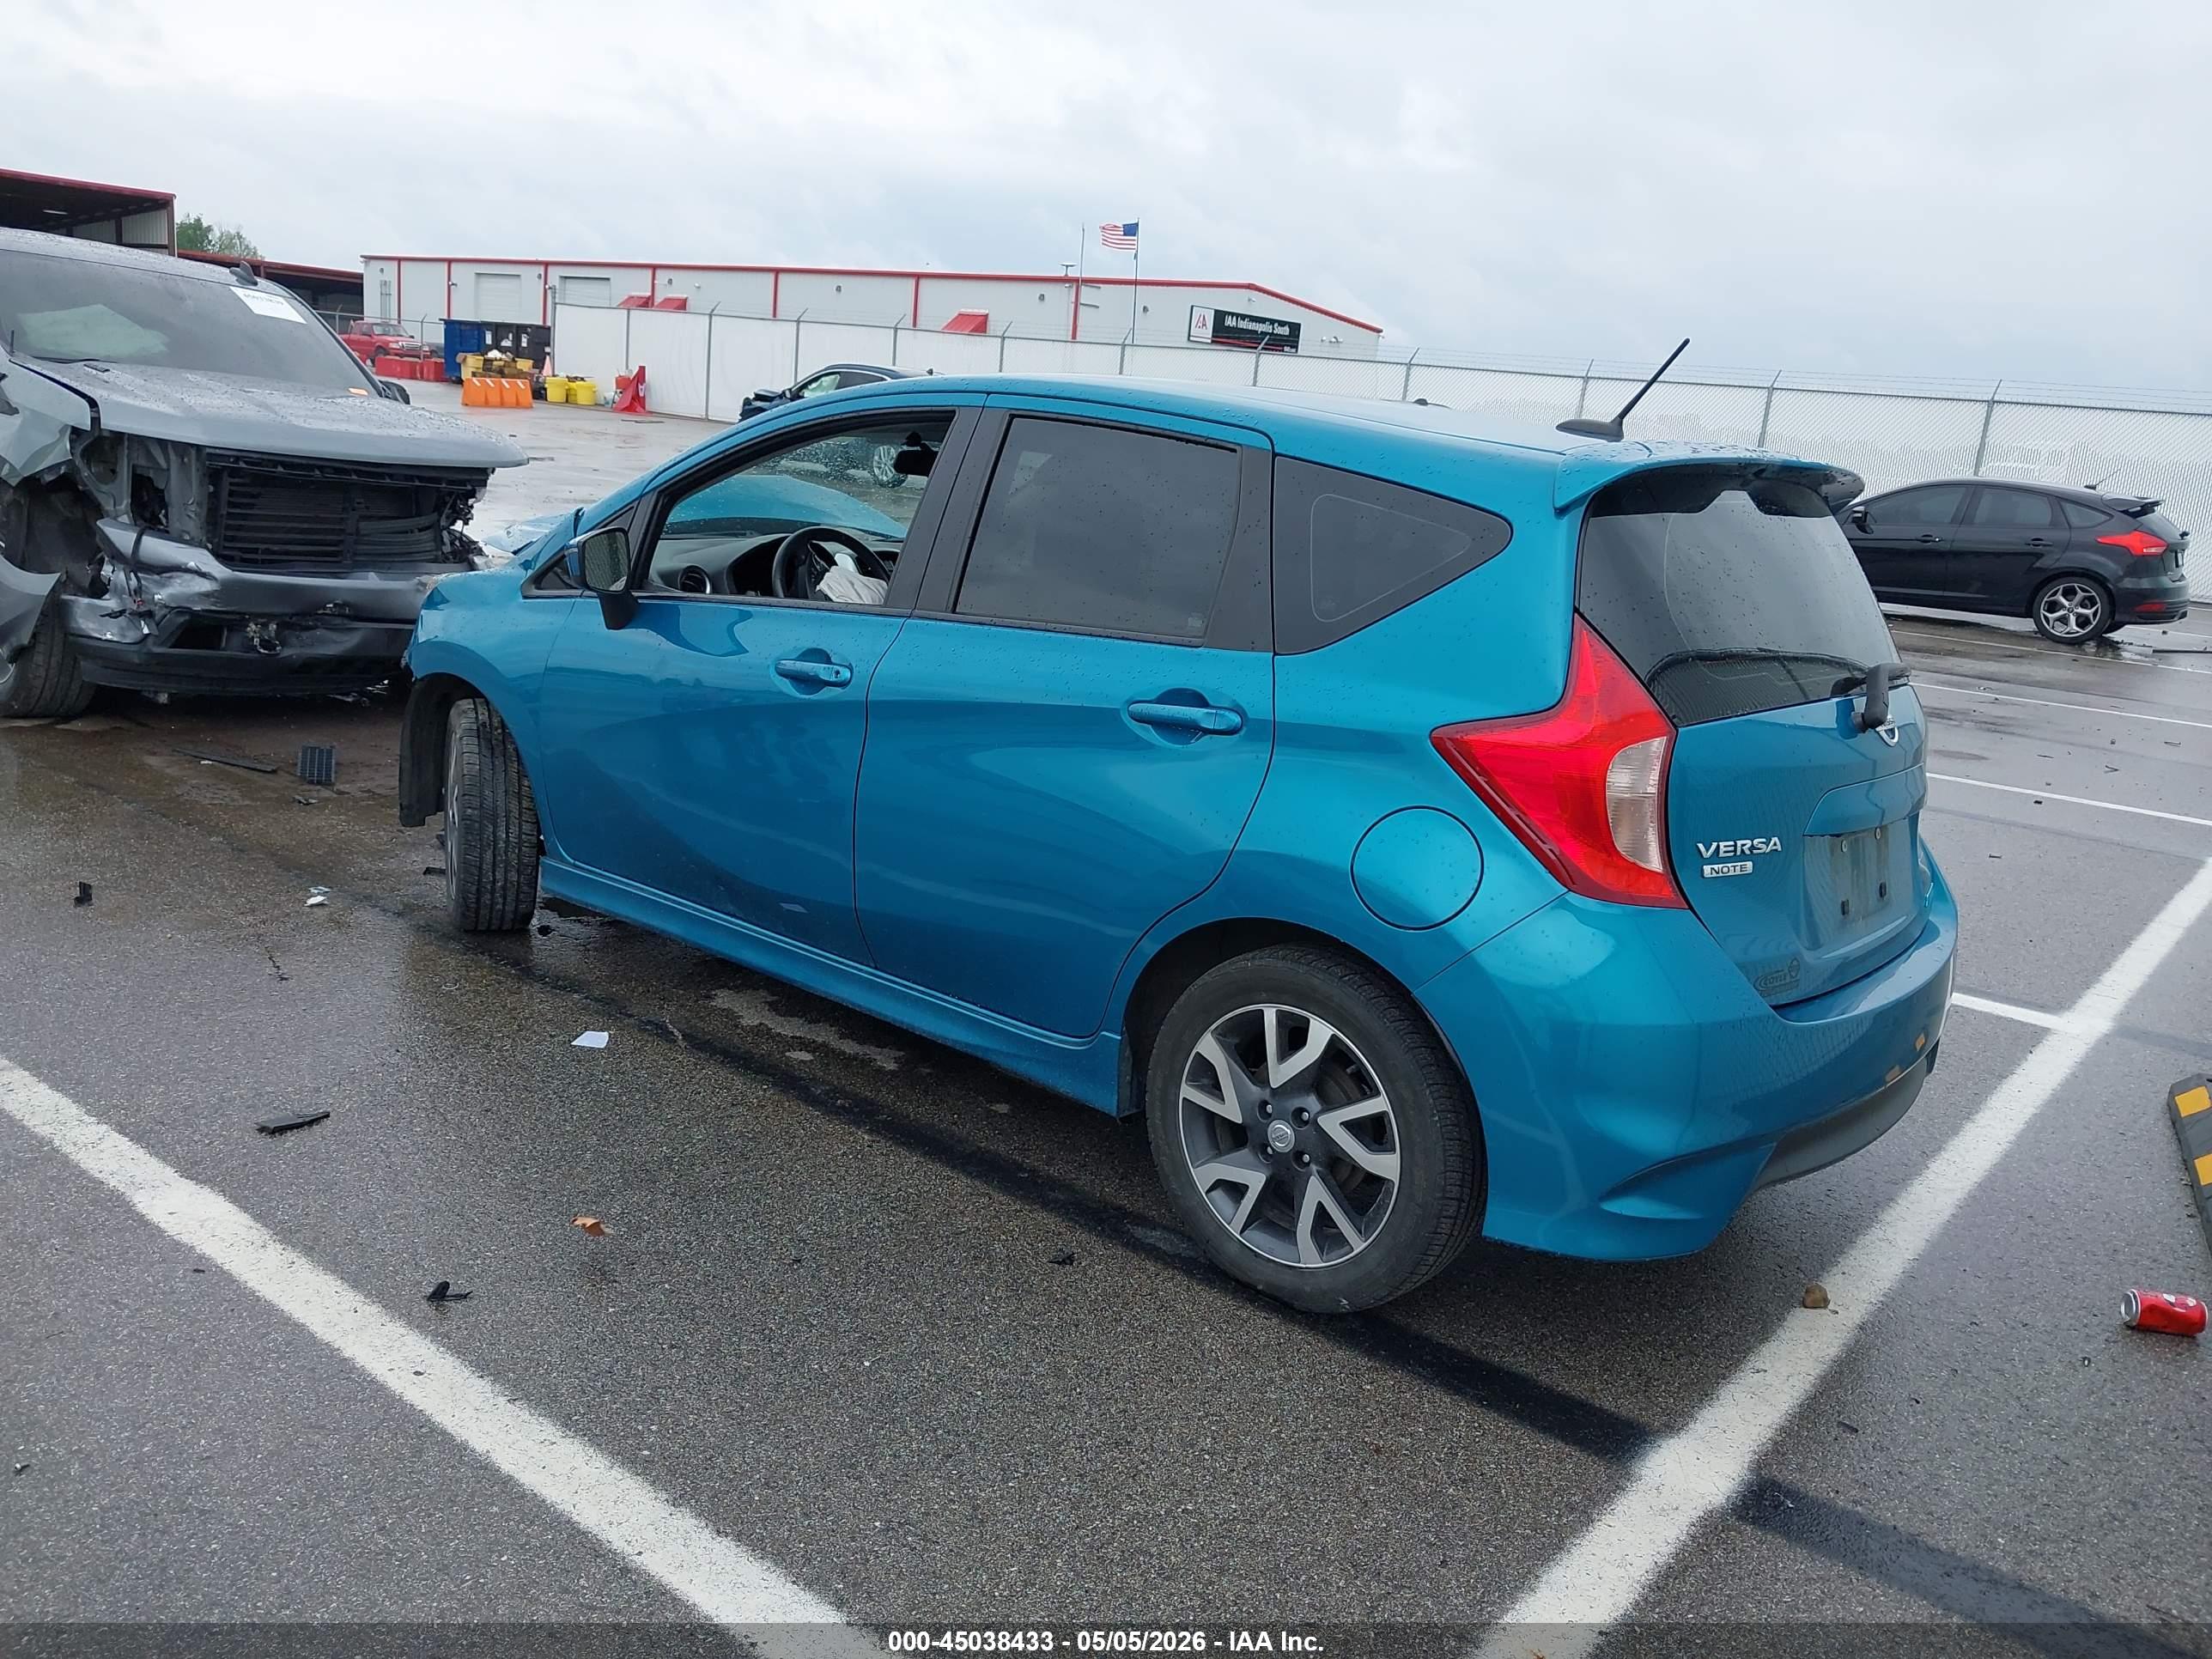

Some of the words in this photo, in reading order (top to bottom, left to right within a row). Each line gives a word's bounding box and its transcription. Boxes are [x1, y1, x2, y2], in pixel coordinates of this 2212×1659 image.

[1224, 314, 1237, 328] IAA
[1237, 316, 1273, 334] Indianapolis
[1273, 322, 1290, 336] South
[1697, 836, 1782, 859] VERSA
[1710, 863, 1748, 875] NOTE
